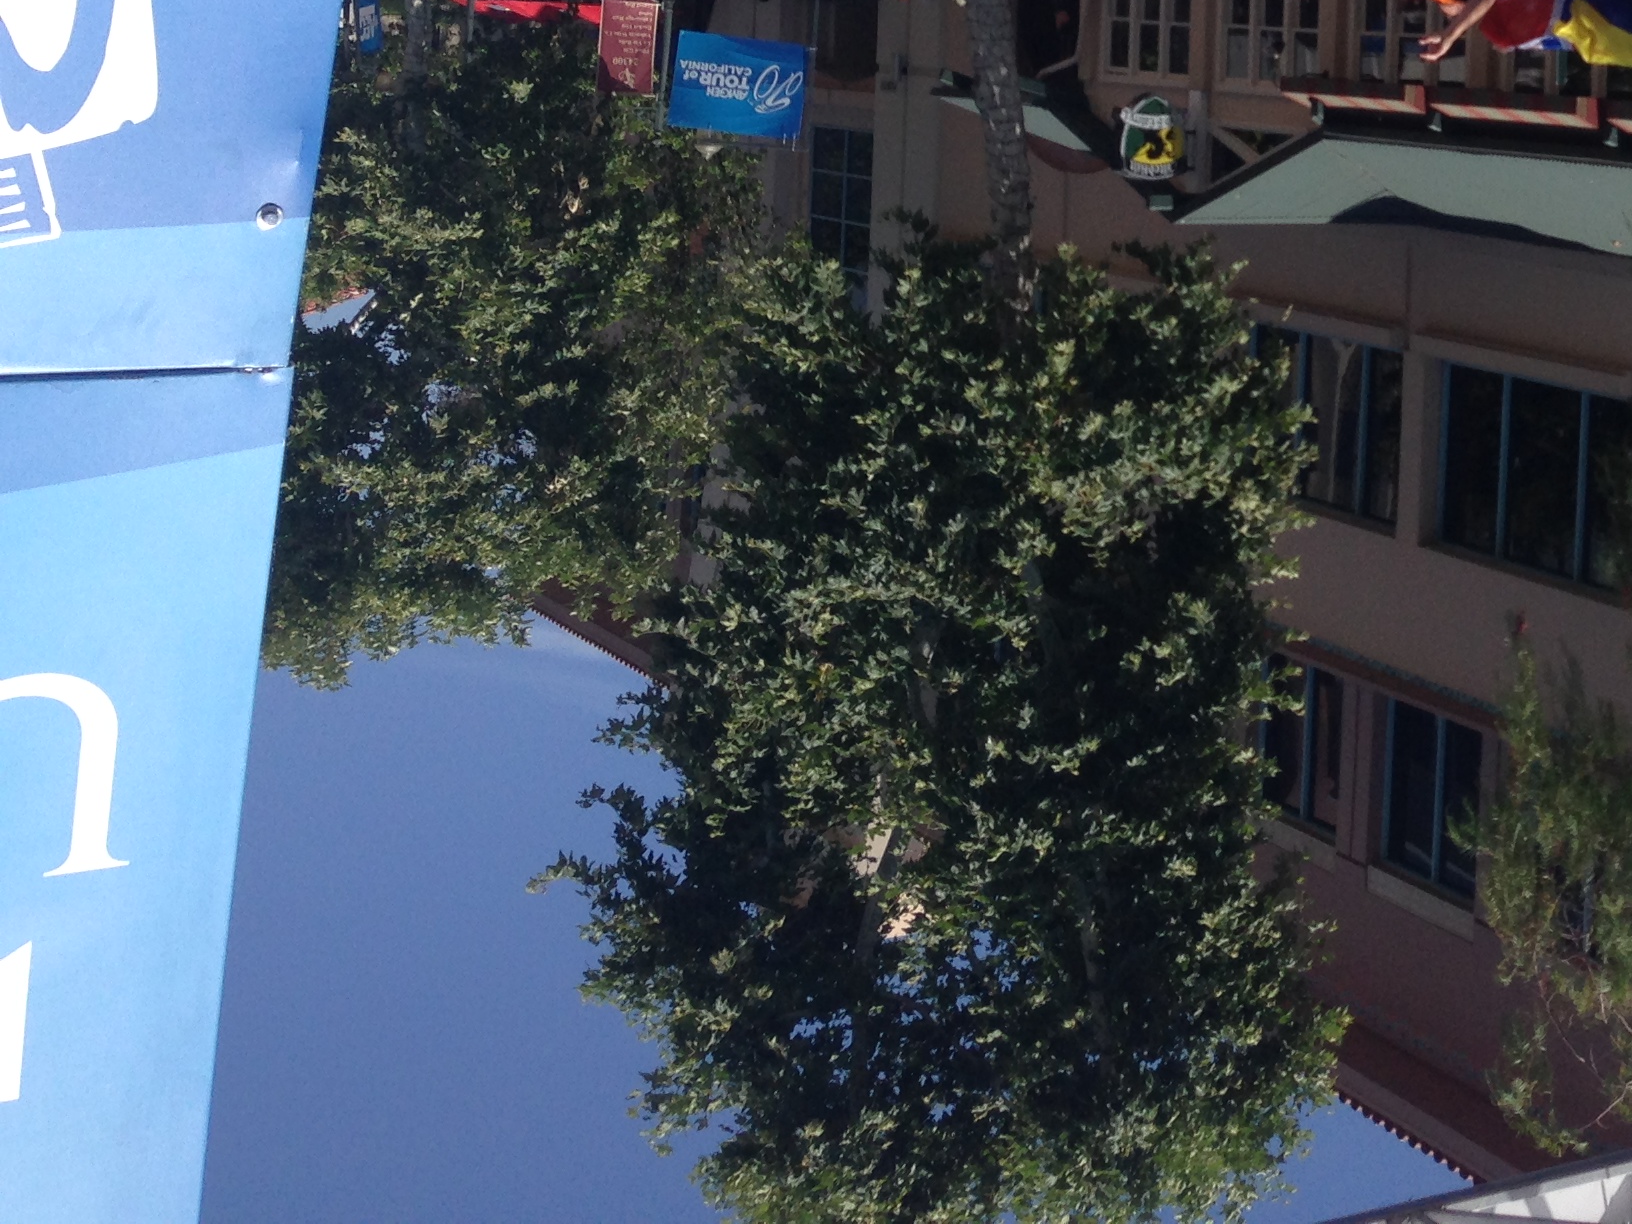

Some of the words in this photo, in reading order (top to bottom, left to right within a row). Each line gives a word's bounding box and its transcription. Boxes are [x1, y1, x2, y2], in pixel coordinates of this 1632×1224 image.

[679, 59, 753, 76] CALIFORNIA
[683, 69, 699, 80] of
[699, 71, 750, 89] TOUR
[706, 86, 749, 101] AMGEN
